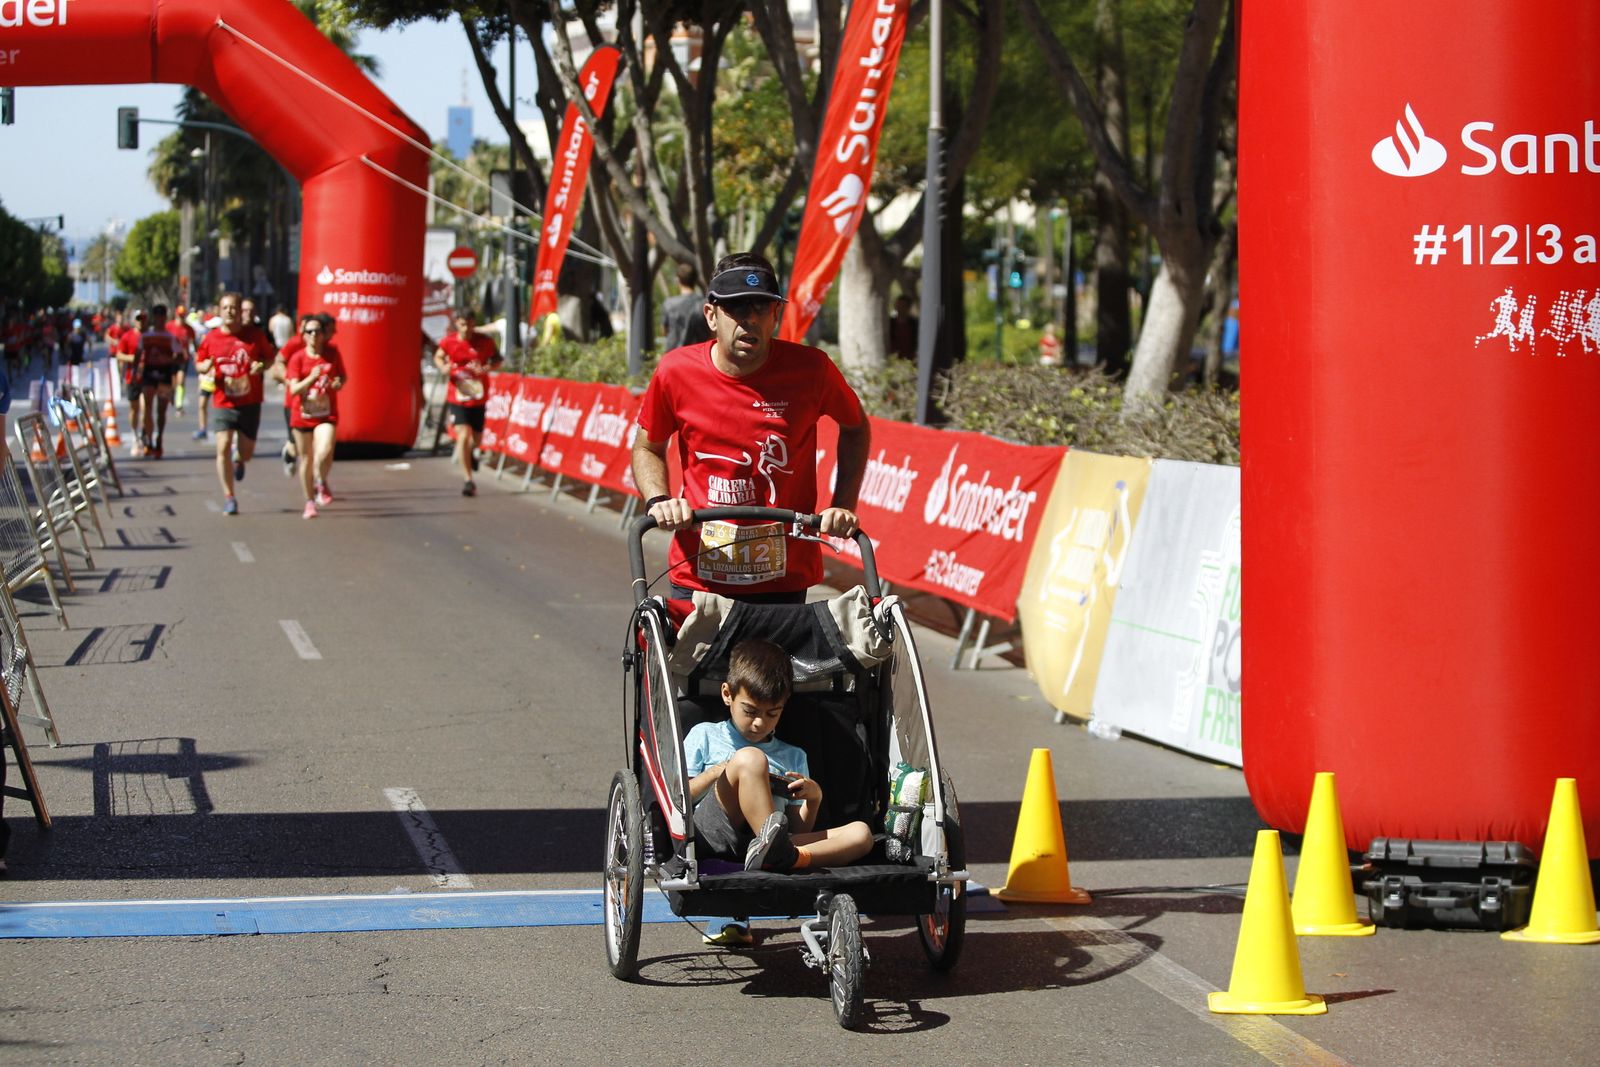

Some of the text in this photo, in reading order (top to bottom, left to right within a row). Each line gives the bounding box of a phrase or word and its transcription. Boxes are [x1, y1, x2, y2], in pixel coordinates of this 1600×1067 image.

[553, 70, 600, 212] Santaner
[708, 474, 756, 493] CARRERA
[707, 487, 756, 505] SOLIDARIA
[938, 463, 1037, 542] Santander
[706, 541, 770, 563] 3112
[713, 562, 752, 573] LOZANILLOS
[753, 562, 772, 572] TEAM
